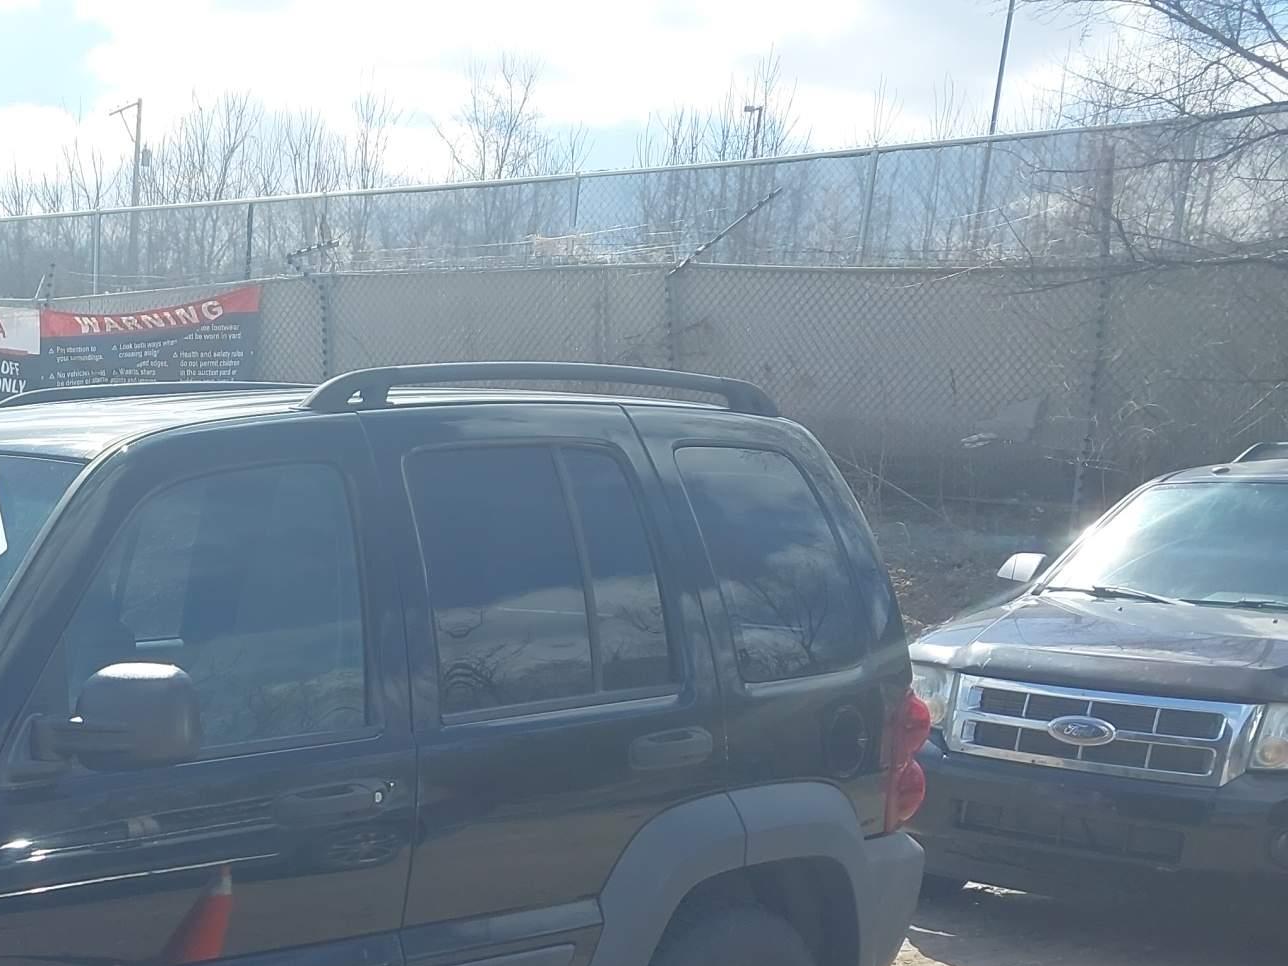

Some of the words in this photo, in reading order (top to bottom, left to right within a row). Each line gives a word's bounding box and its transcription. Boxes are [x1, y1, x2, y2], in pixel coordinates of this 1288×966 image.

[74, 300, 224, 334] WARNING
[119, 342, 133, 350] Look
[200, 350, 212, 358] and
[0, 359, 20, 376] OFF
